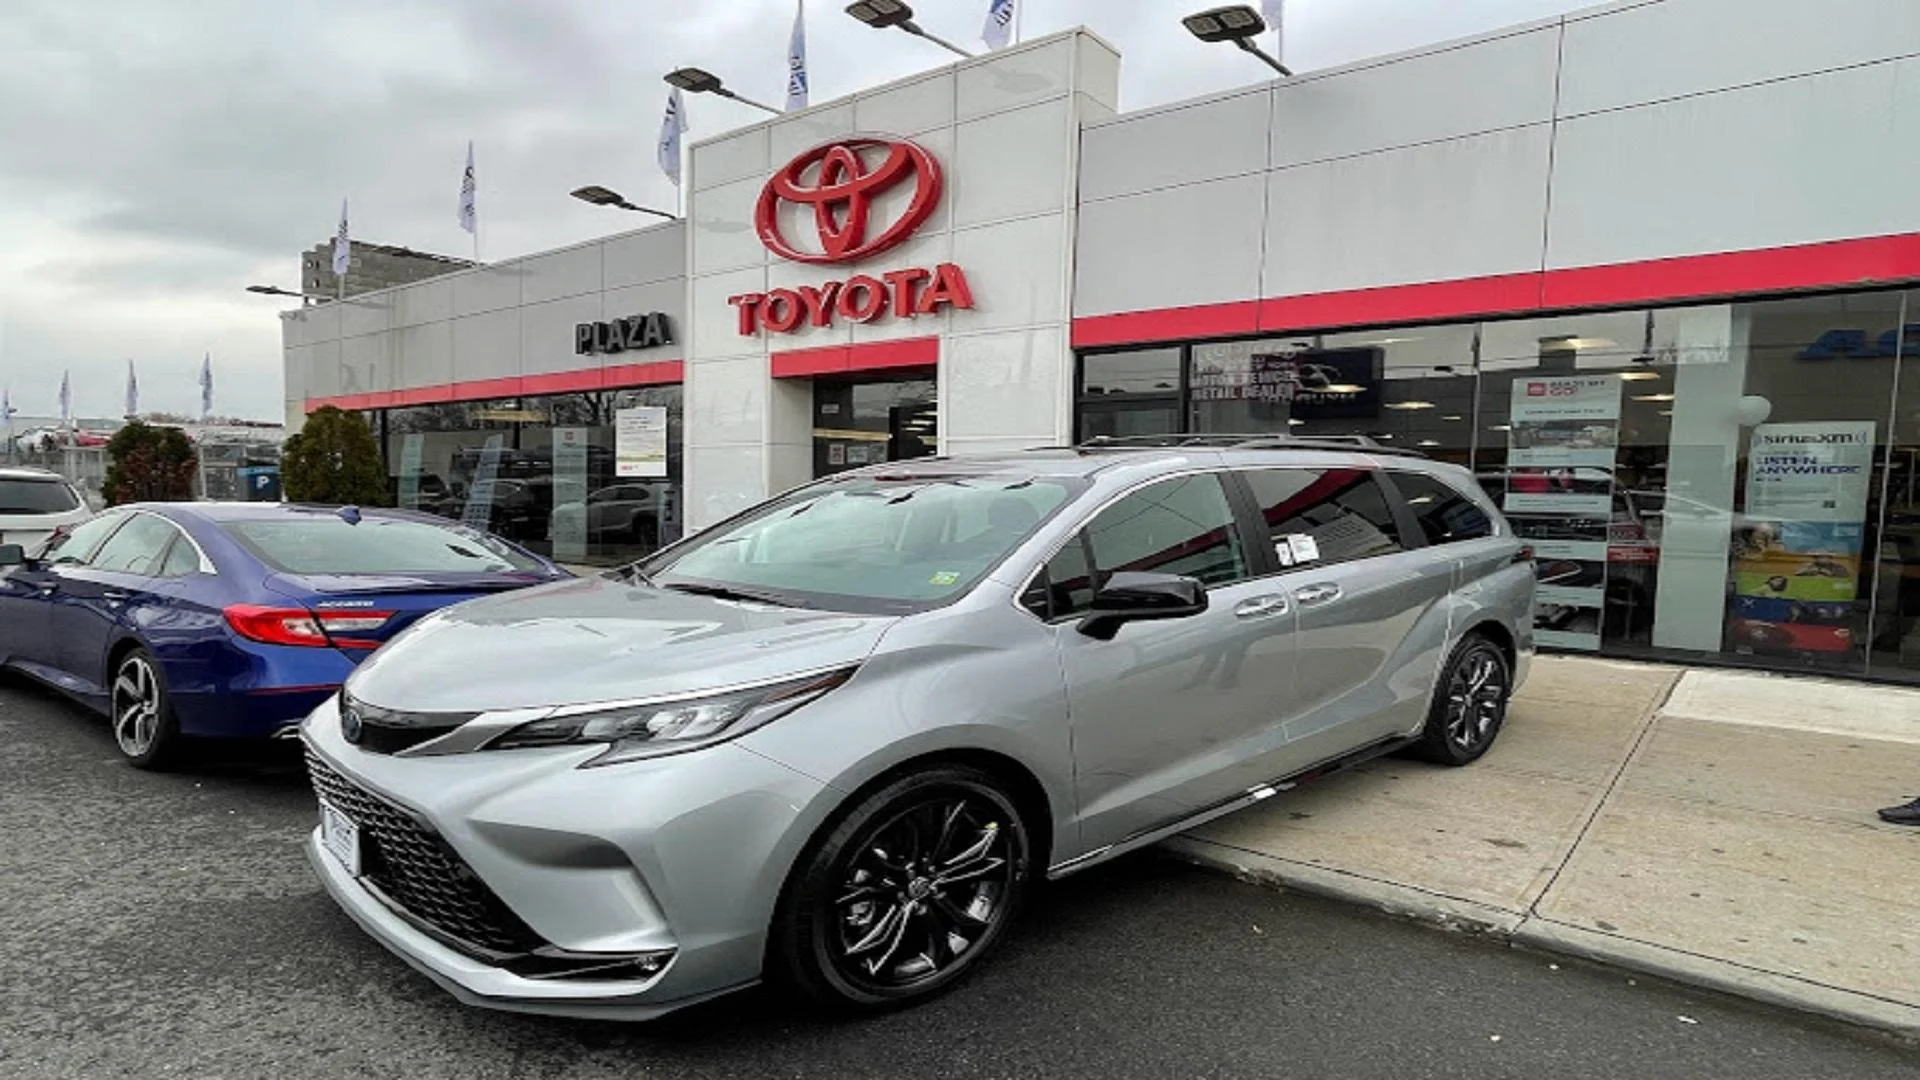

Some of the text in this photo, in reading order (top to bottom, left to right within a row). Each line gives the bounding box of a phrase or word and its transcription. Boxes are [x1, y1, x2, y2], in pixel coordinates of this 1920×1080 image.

[728, 262, 974, 336] TOYOTA
[576, 311, 672, 355] PLAZA
[255, 475, 270, 489] P
